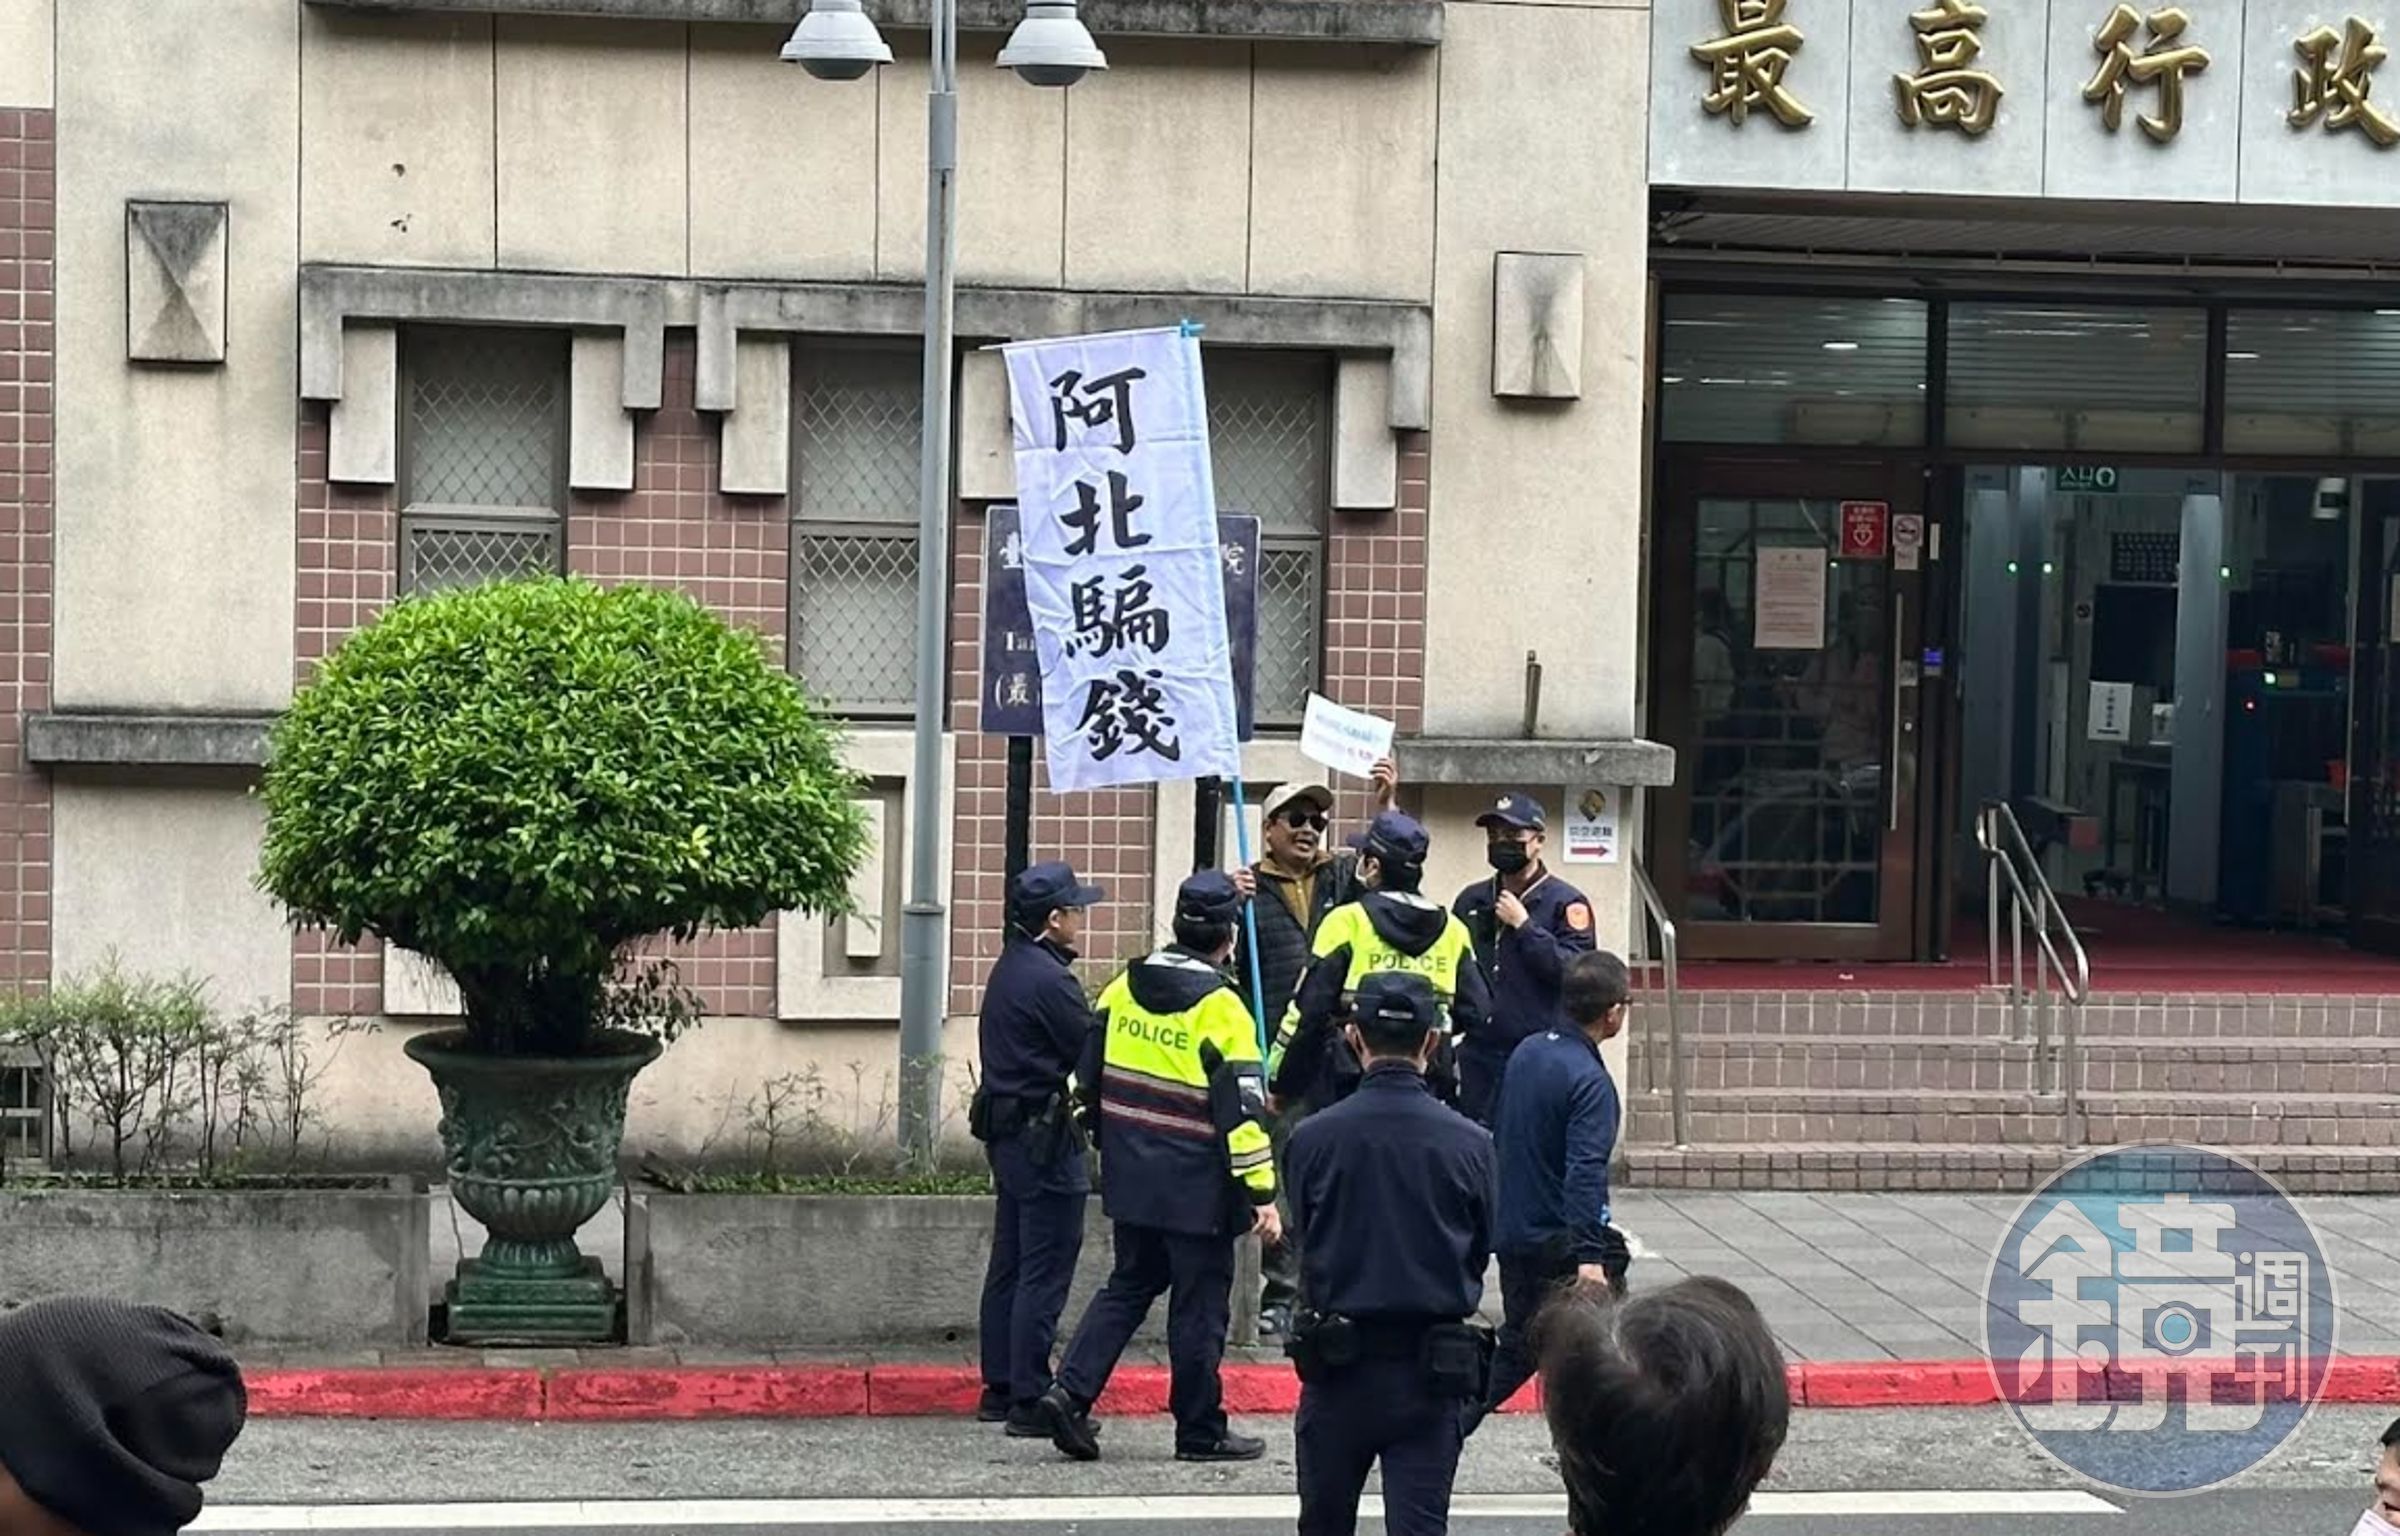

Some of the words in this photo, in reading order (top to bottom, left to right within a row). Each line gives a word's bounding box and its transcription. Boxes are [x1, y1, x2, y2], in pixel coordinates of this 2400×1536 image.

[1690, 0, 2400, 146] 最高行政
[1047, 366, 1181, 763] 阿北騙錢
[1368, 953, 1448, 973] POLCE
[1116, 1015, 1190, 1051] POLICE
